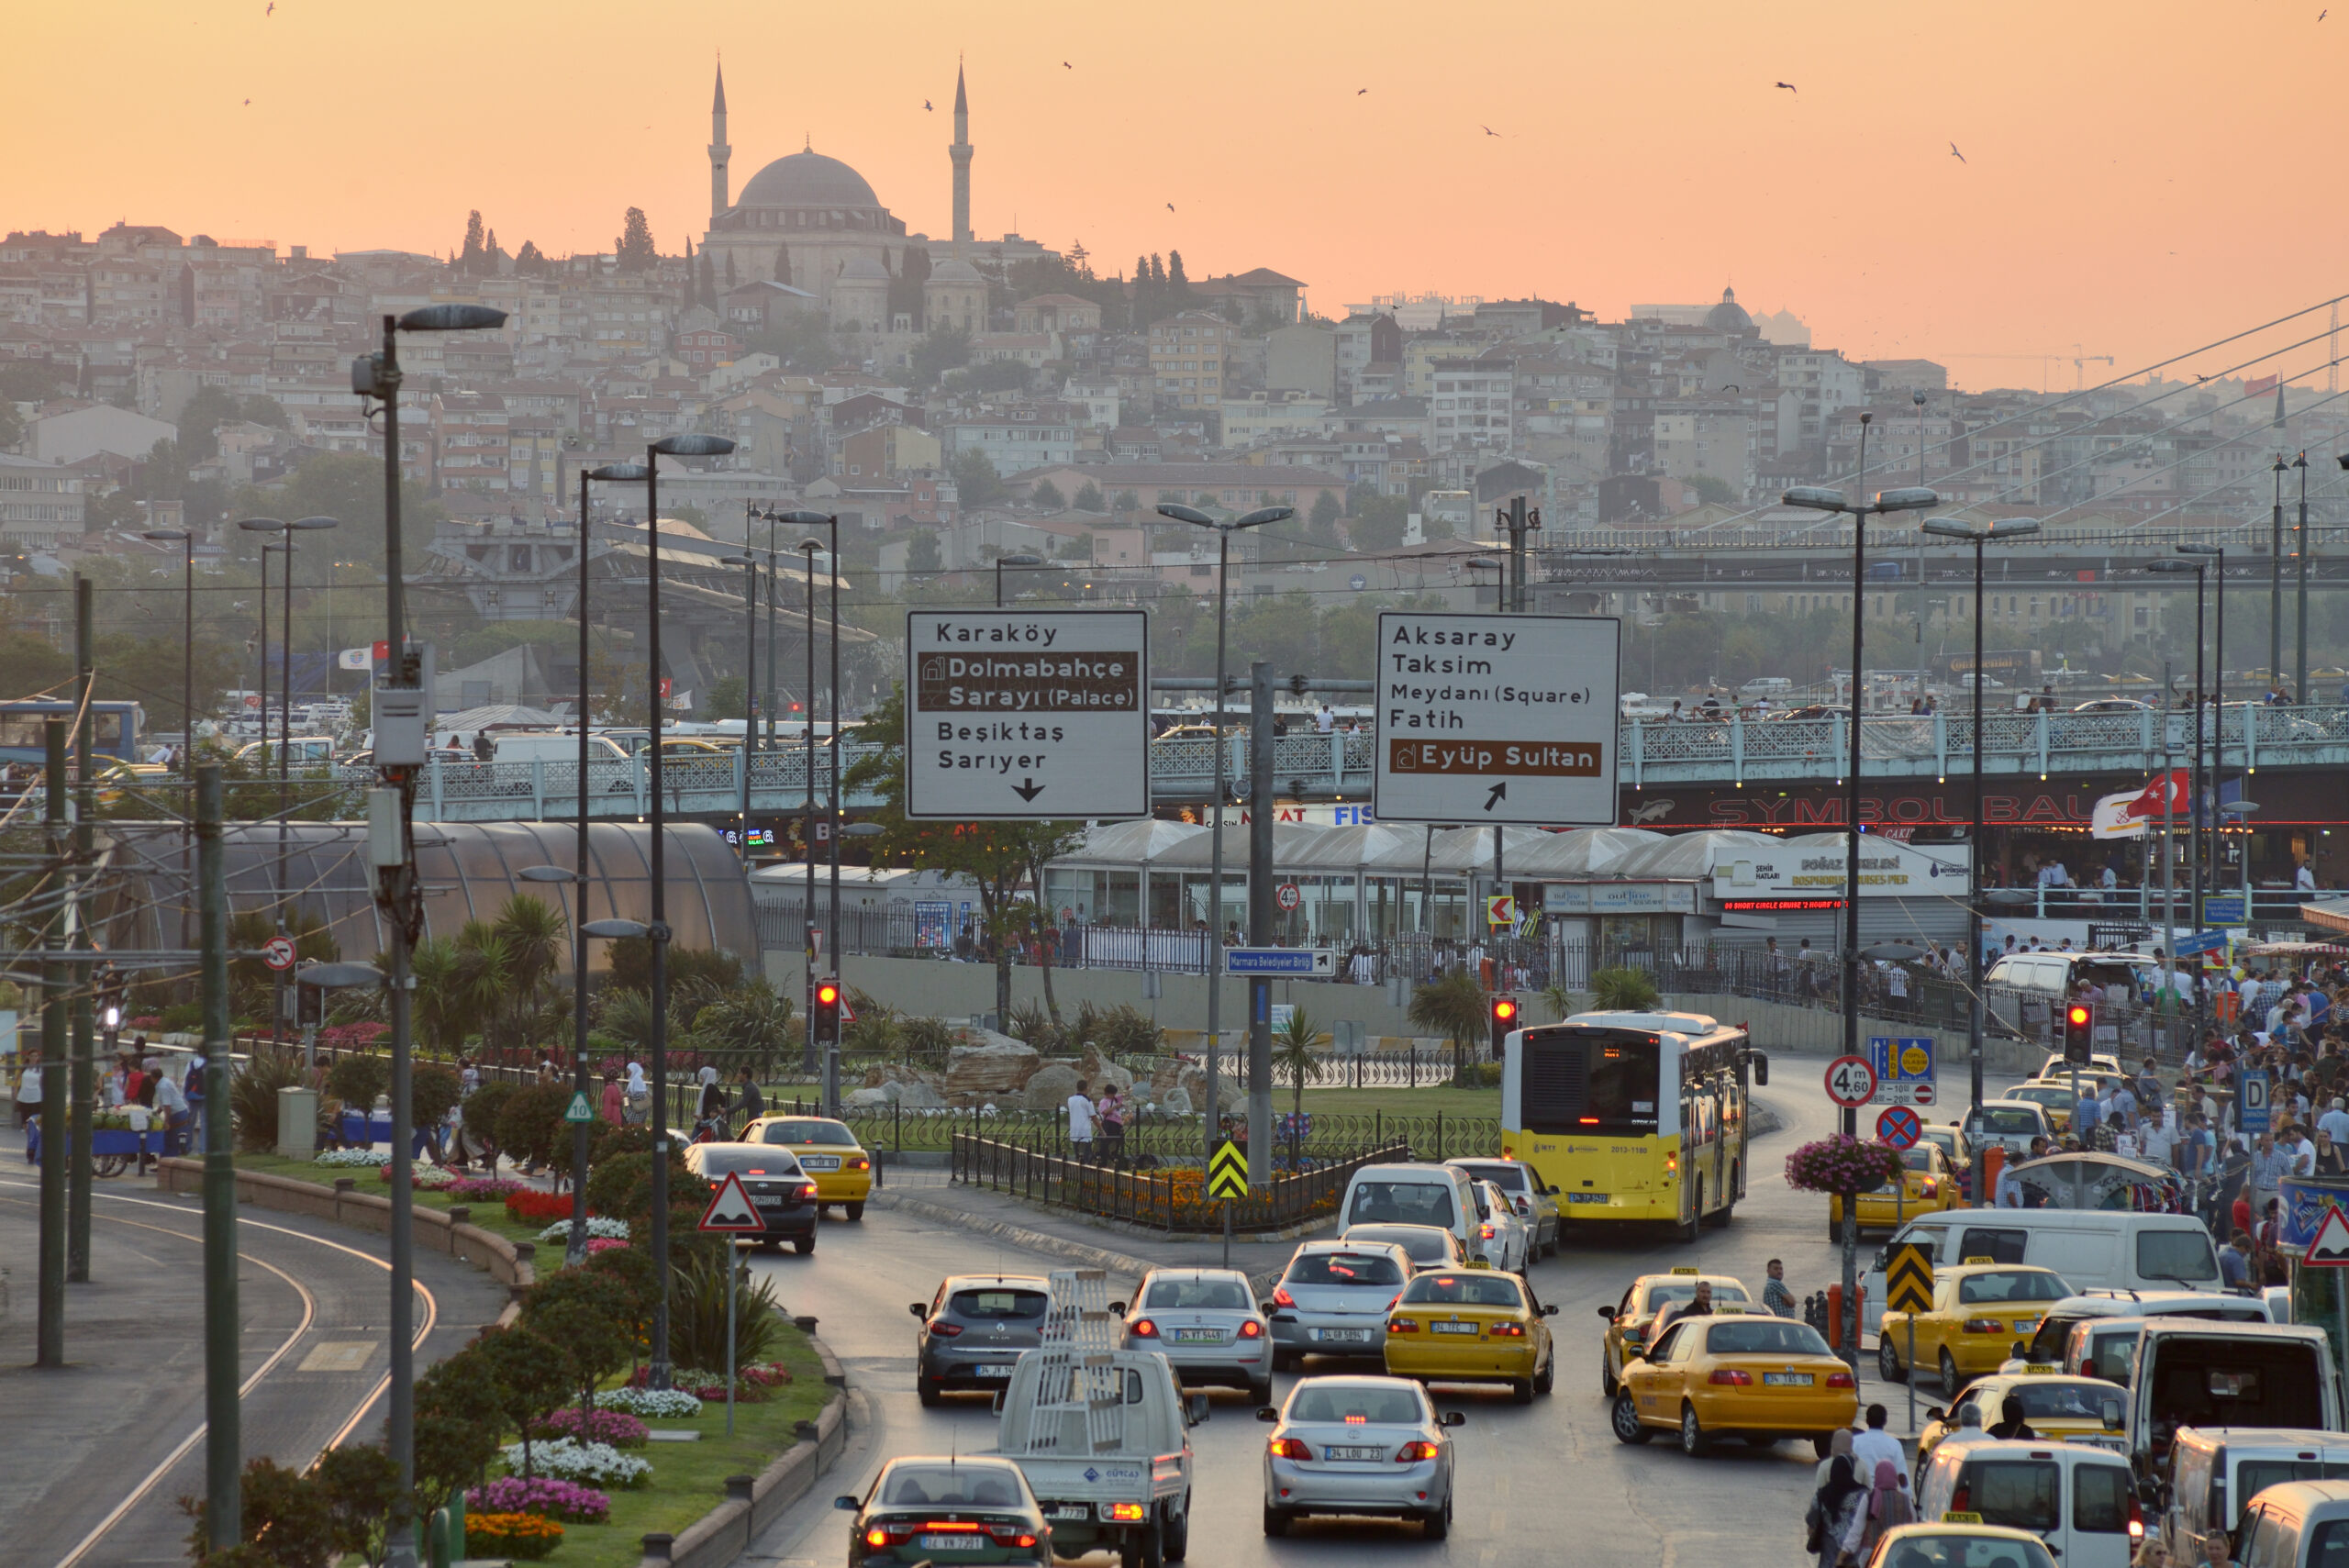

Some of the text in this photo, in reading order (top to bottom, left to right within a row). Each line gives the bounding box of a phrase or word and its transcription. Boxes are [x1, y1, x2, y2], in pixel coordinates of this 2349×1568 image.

[937, 623, 1057, 647] Karaköy
[1393, 626, 1516, 651] Aksaray
[949, 658, 1124, 679] Dolmabahçe
[1392, 653, 1491, 674] Taksim
[949, 686, 1133, 710] Sarayı (Palace)
[1391, 684, 1590, 706] Meydanı (Square)
[1390, 709, 1464, 728] Fatih
[938, 722, 1064, 742] Beşiktaş
[939, 751, 1046, 773] Sarıyer
[1422, 744, 1593, 771] Eyüp Sultan
[1241, 808, 1307, 824] MAT
[1335, 806, 1373, 825] FIS
[1709, 795, 2095, 824] SYMBOL BAL
[1755, 863, 1773, 873] ŞEHİR
[1792, 875, 1846, 886] BOSPHORUS
[1887, 874, 1909, 884] PIER
[1230, 955, 1311, 970] Marmara Belediyeler Birliği
[1834, 1068, 1850, 1092] 4
[2248, 1081, 2262, 1107] D
[573, 1105, 587, 1117] 10
[1610, 1145, 1648, 1154] 2013-1180
[2021, 1322, 2029, 1330] 34
[1330, 1448, 1341, 1459] 34
[1370, 1449, 1380, 1459] 23
